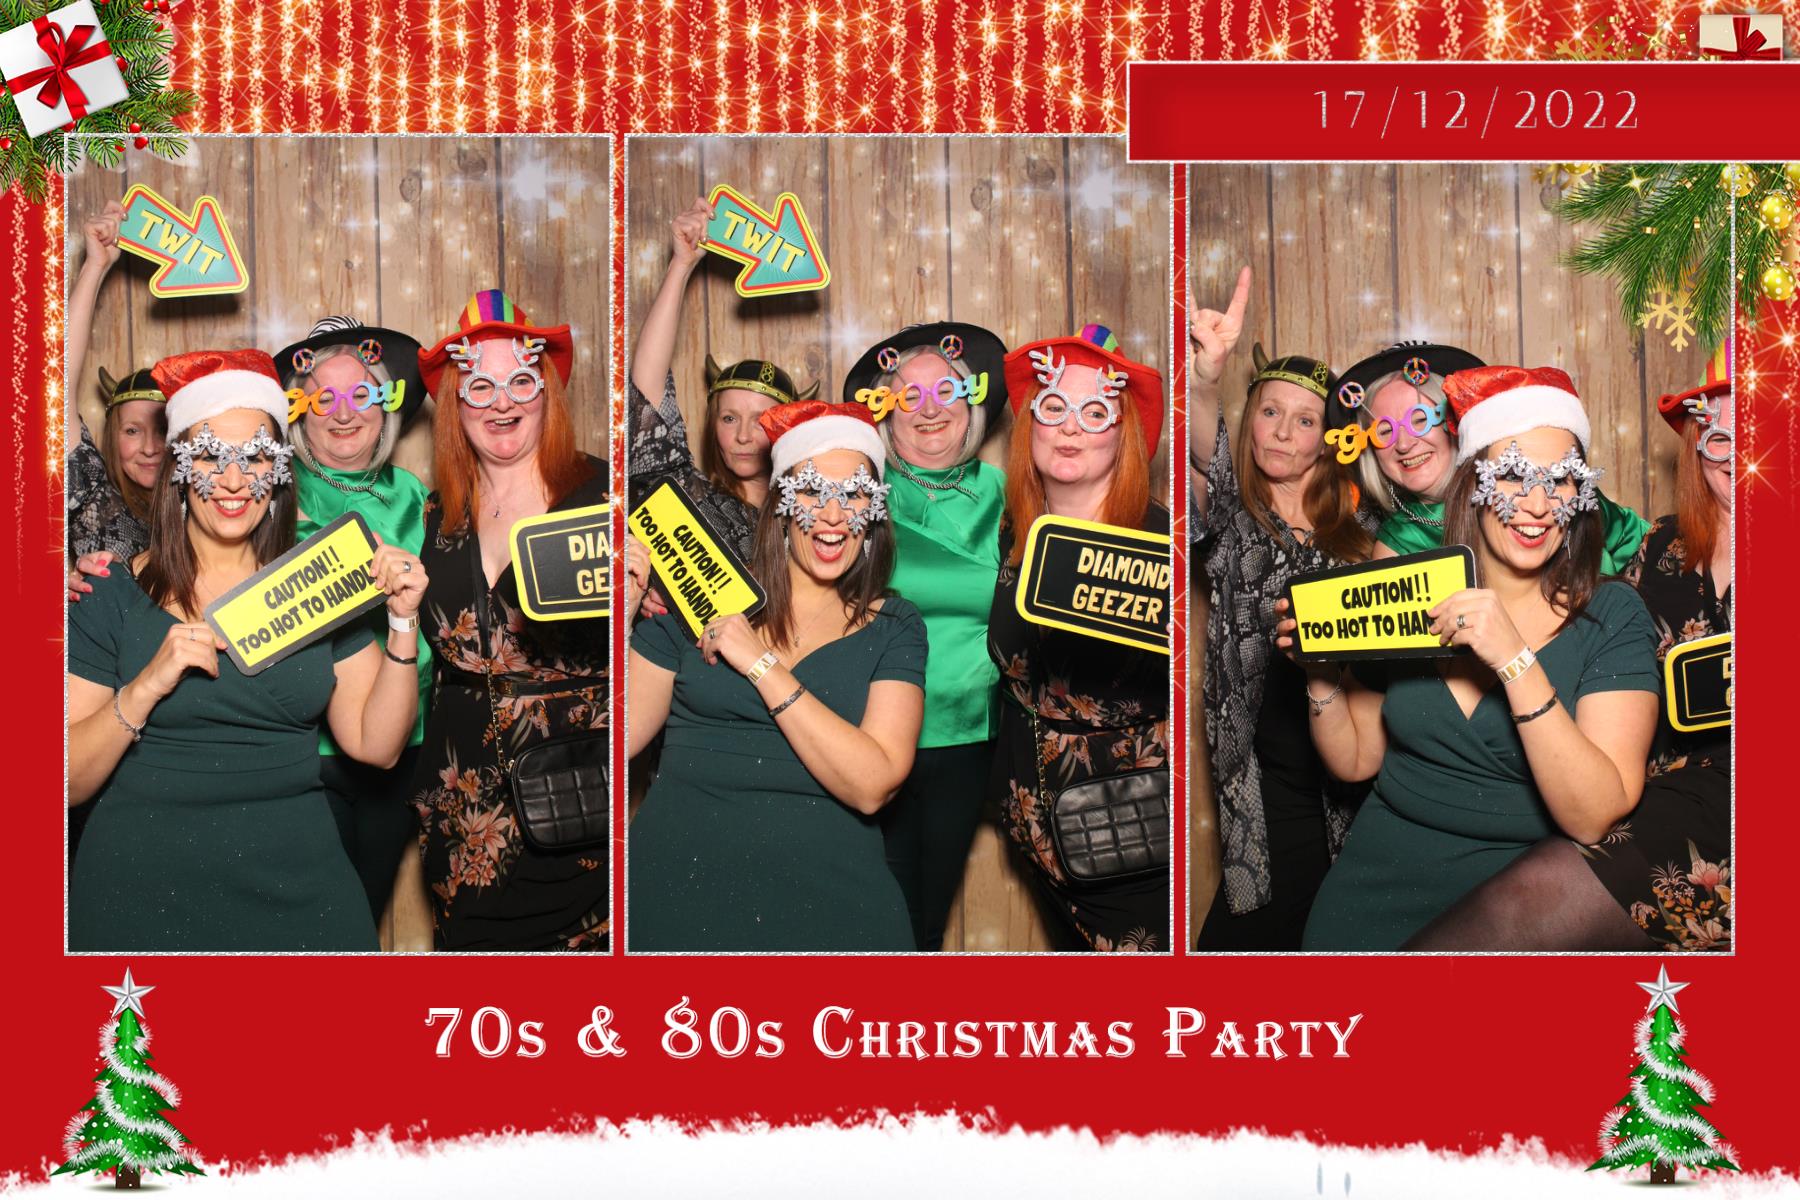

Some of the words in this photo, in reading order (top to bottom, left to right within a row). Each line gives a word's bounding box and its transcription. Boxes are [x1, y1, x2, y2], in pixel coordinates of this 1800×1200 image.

[138, 209, 226, 275] TWIT
[723, 209, 808, 273] TWIT
[263, 545, 345, 610] CAUTION!!
[635, 506, 658, 537] TOO
[650, 532, 678, 562] HOT
[668, 558, 688, 581] TO
[678, 575, 721, 626] HANDL
[672, 524, 733, 595] CAUTION!!
[1077, 547, 1170, 590] DIAMOND
[1072, 583, 1163, 624] GEEZER
[1341, 572, 1431, 610] CAUTION!!
[236, 628, 272, 655] TOO
[269, 606, 303, 638] HOT
[300, 594, 325, 619] TO
[1301, 621, 1334, 640] TOO
[1337, 616, 1369, 639] HOT
[1372, 614, 1395, 637] TO
[1397, 609, 1436, 637] HAN
